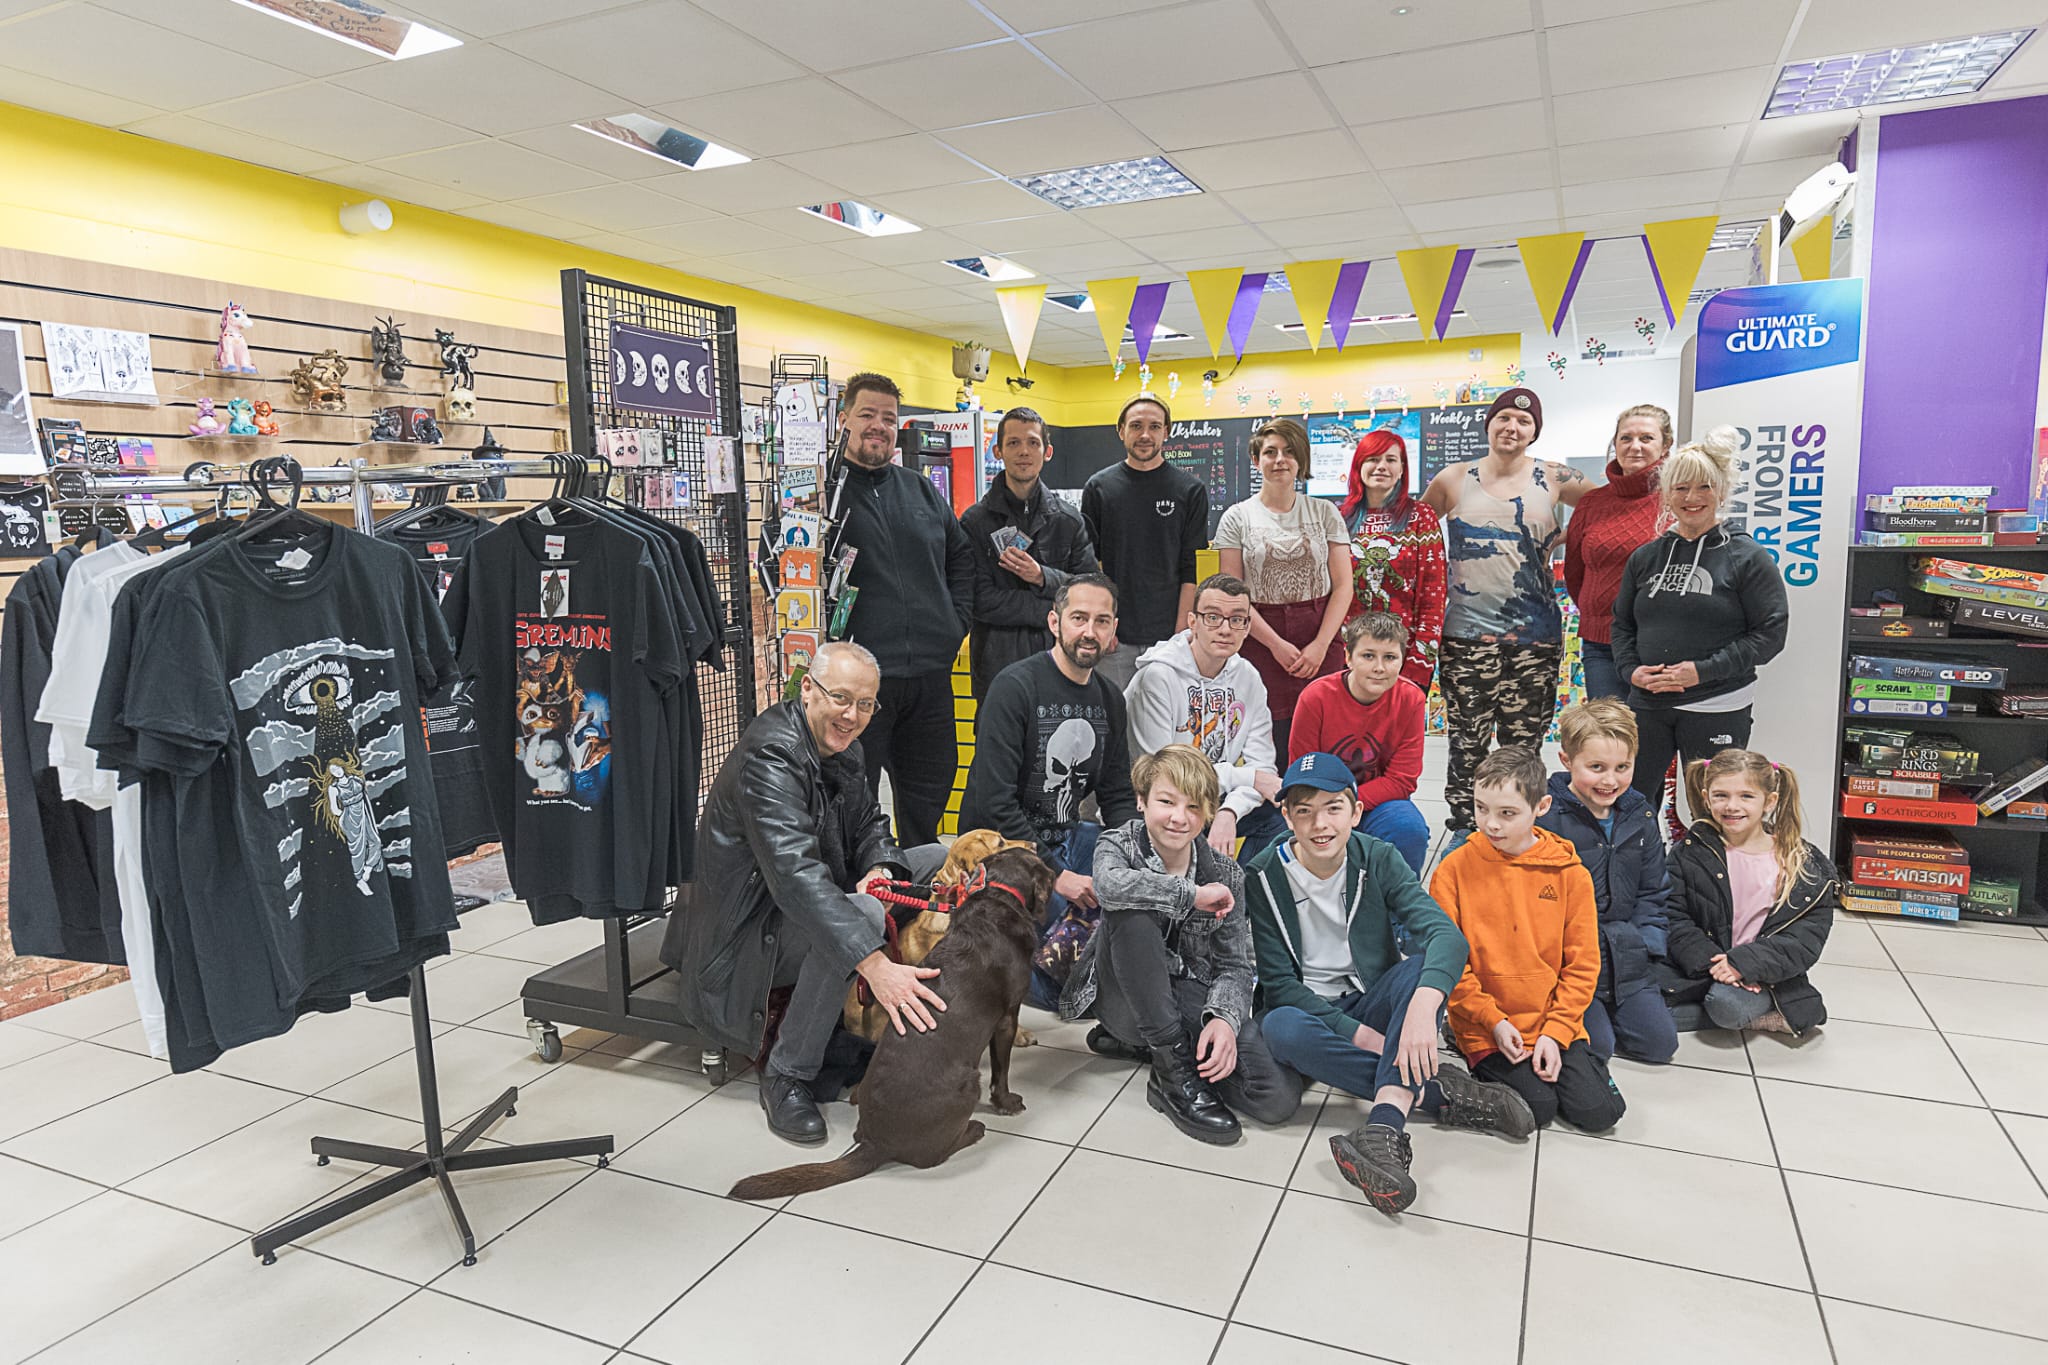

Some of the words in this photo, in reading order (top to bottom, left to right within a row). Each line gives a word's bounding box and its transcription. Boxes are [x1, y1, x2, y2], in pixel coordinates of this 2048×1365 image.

[1738, 313, 1817, 331] ULTIMATE
[1430, 411, 1473, 429] Weekly
[1170, 421, 1223, 439] lkshakes
[1754, 425, 1786, 517] FROM
[1784, 424, 1826, 587] GAMERS
[1890, 516, 1937, 526] Bloodborne
[1668, 564, 1693, 573] THE
[1981, 608, 2045, 625] LEVEL
[1940, 670, 1992, 681] CLUEDO
[1875, 683, 1912, 694] SCRAWL
[1902, 749, 1938, 760] LORD
[1901, 759, 1938, 771] RINGS
[1895, 770, 1939, 779] SCRABBLE
[1881, 807, 1957, 820] SCATTERGORIES
[1891, 850, 1921, 859] PEOPLE'S
[1922, 853, 1947, 861] CHOICE
[1894, 867, 1964, 887] MUSEUM
[1968, 889, 2009, 903] OUTLAWS
[1908, 905, 1936, 916] WORLD'S
[1937, 909, 1952, 918] FAIR
